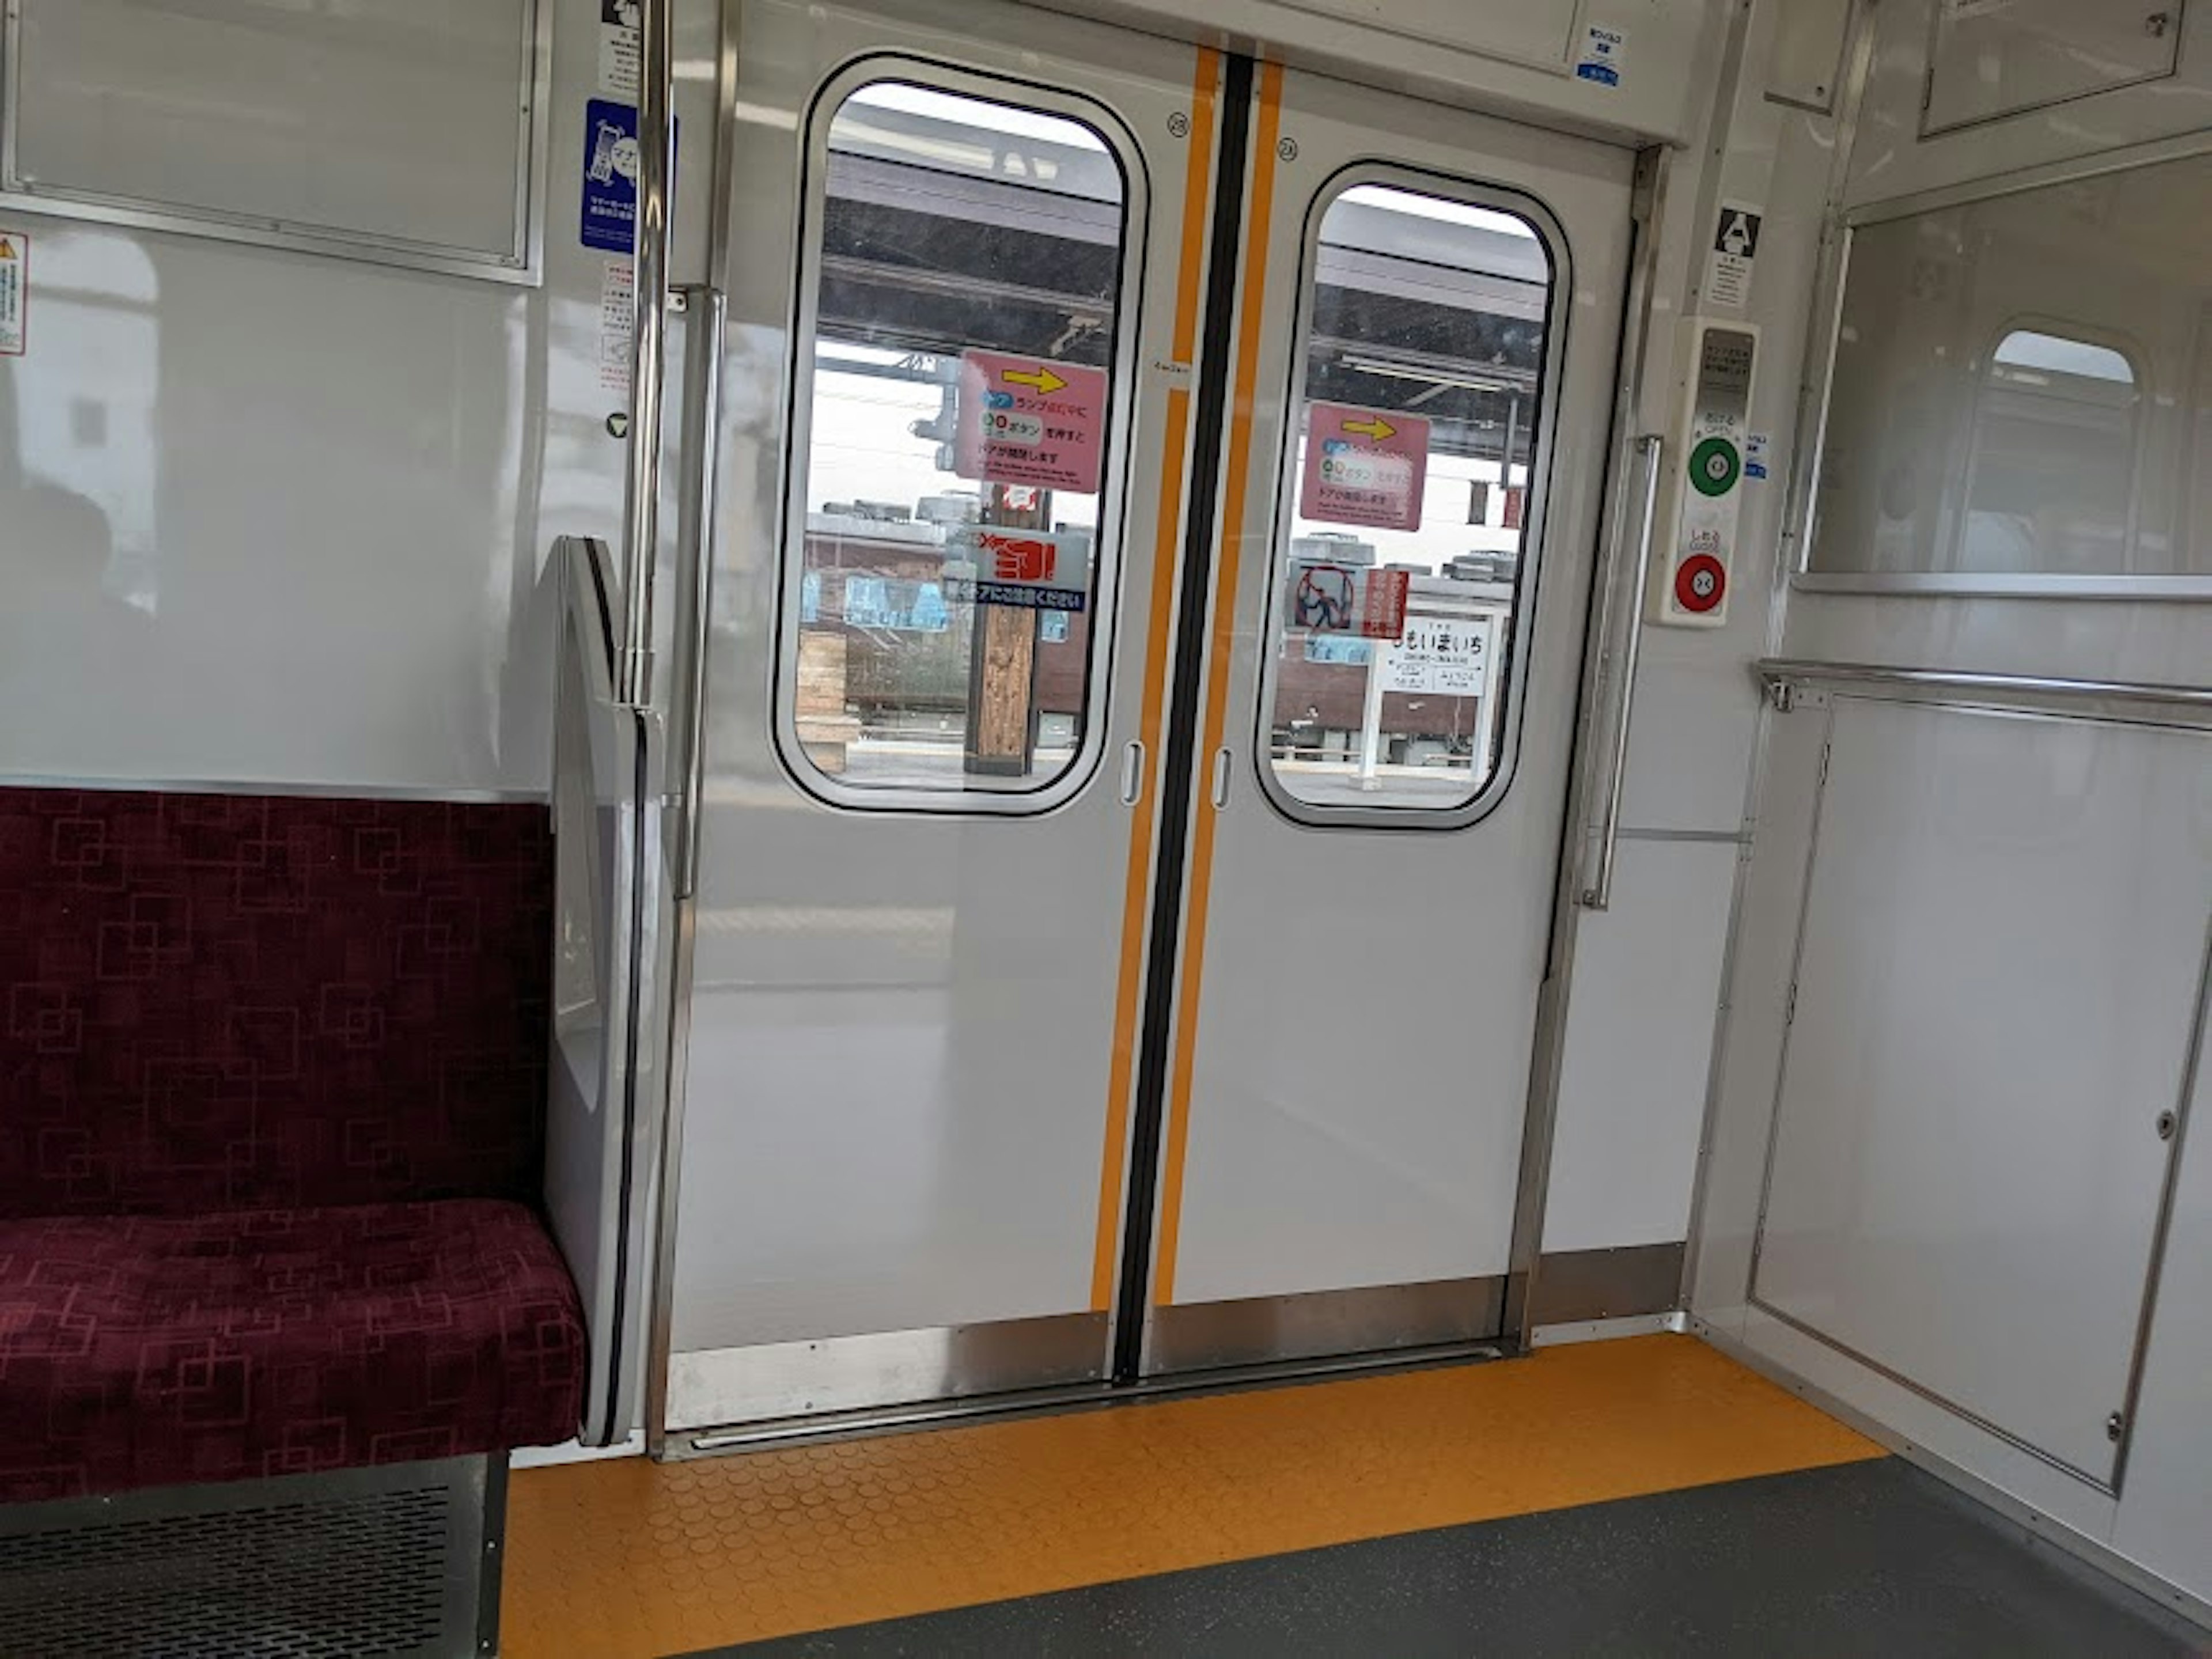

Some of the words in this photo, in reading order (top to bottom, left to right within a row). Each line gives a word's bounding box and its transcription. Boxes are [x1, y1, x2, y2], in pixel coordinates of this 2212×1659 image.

[1010, 422, 1040, 435] ボタン
[1047, 427, 1085, 443] を押すと
[979, 444, 1059, 463] ドアが開閉します
